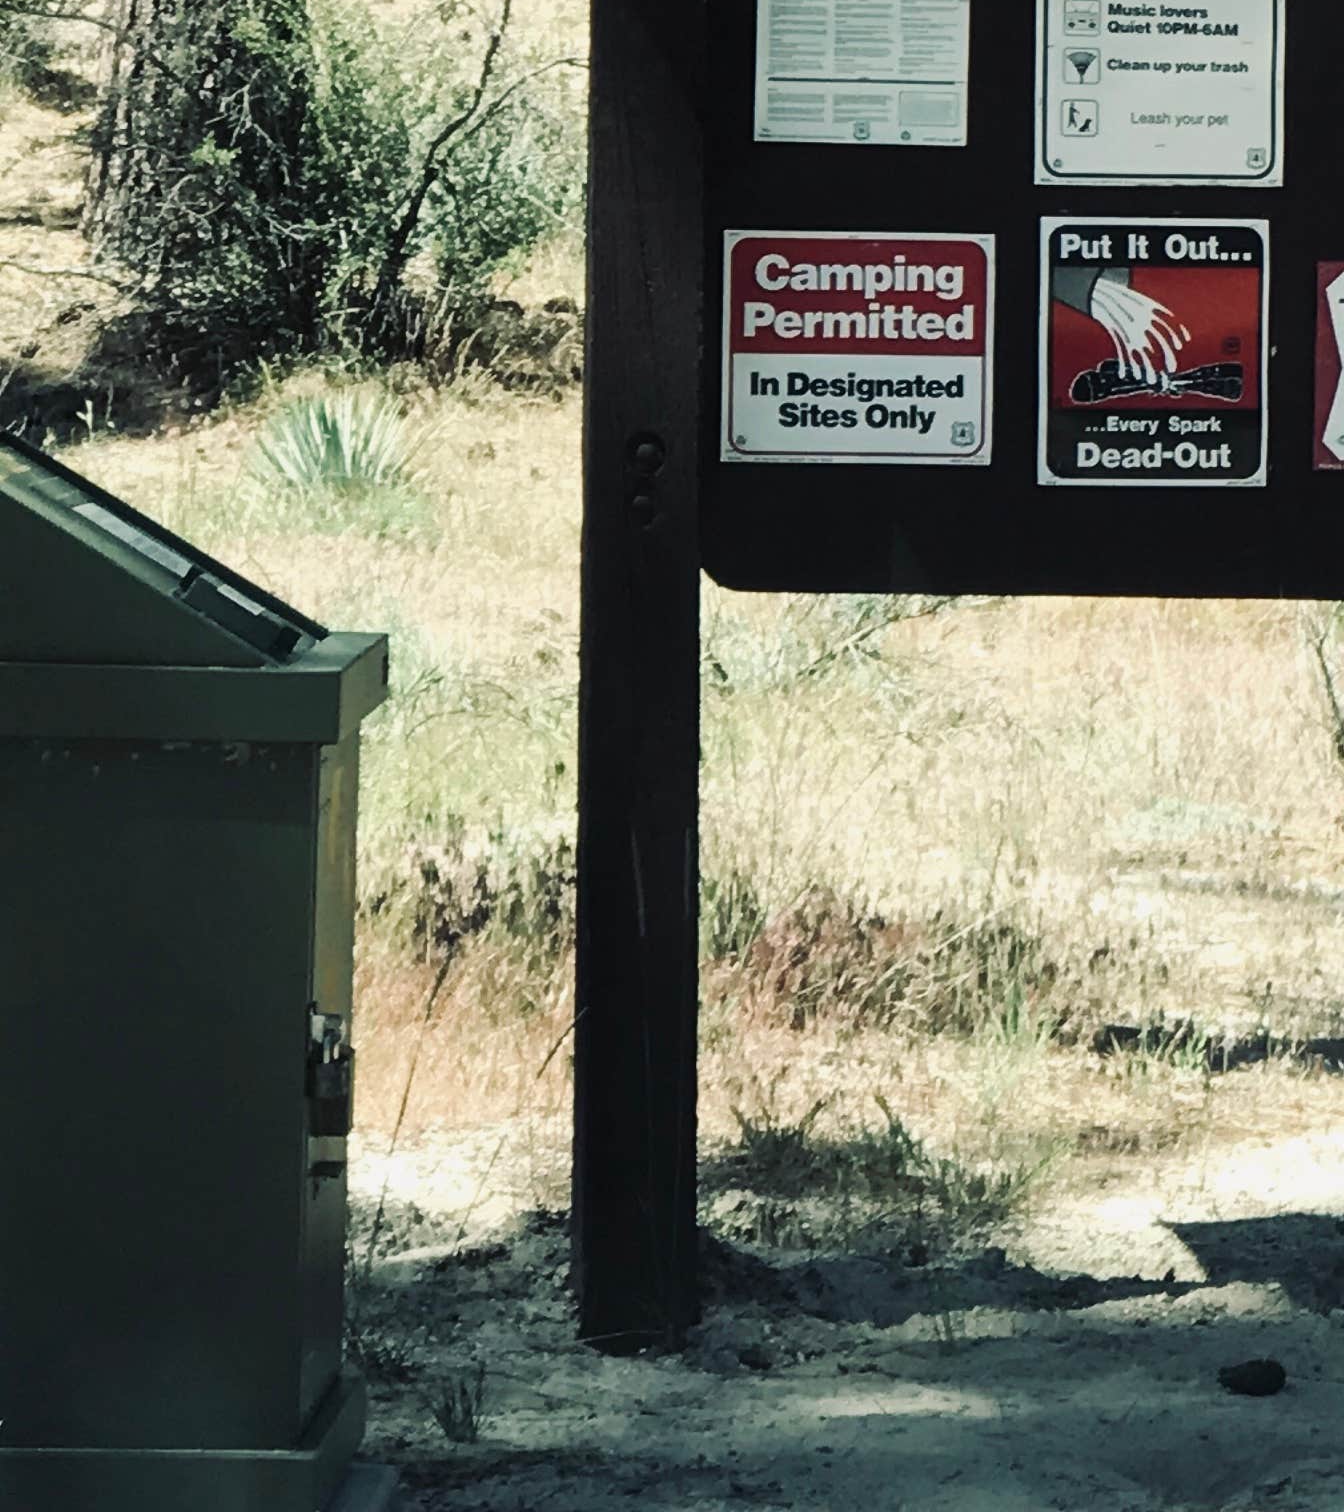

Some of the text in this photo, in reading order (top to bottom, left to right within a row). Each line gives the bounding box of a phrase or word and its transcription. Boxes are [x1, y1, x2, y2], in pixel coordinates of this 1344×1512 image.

[1108, 4, 1208, 18] Music lovers
[1108, 21, 1239, 36] Quiet 10PM-6AM
[1107, 59, 1248, 73] Clean up your trash
[1131, 112, 1228, 127] Leash your pet
[1060, 233, 1252, 261] Put It Out...
[755, 254, 964, 300] Camping
[743, 302, 974, 340] Permitted
[751, 372, 964, 402] In Designated
[778, 402, 936, 434] Sites Only
[1085, 416, 1221, 435] ...Every Spark
[1077, 441, 1231, 468] Dead-Out
